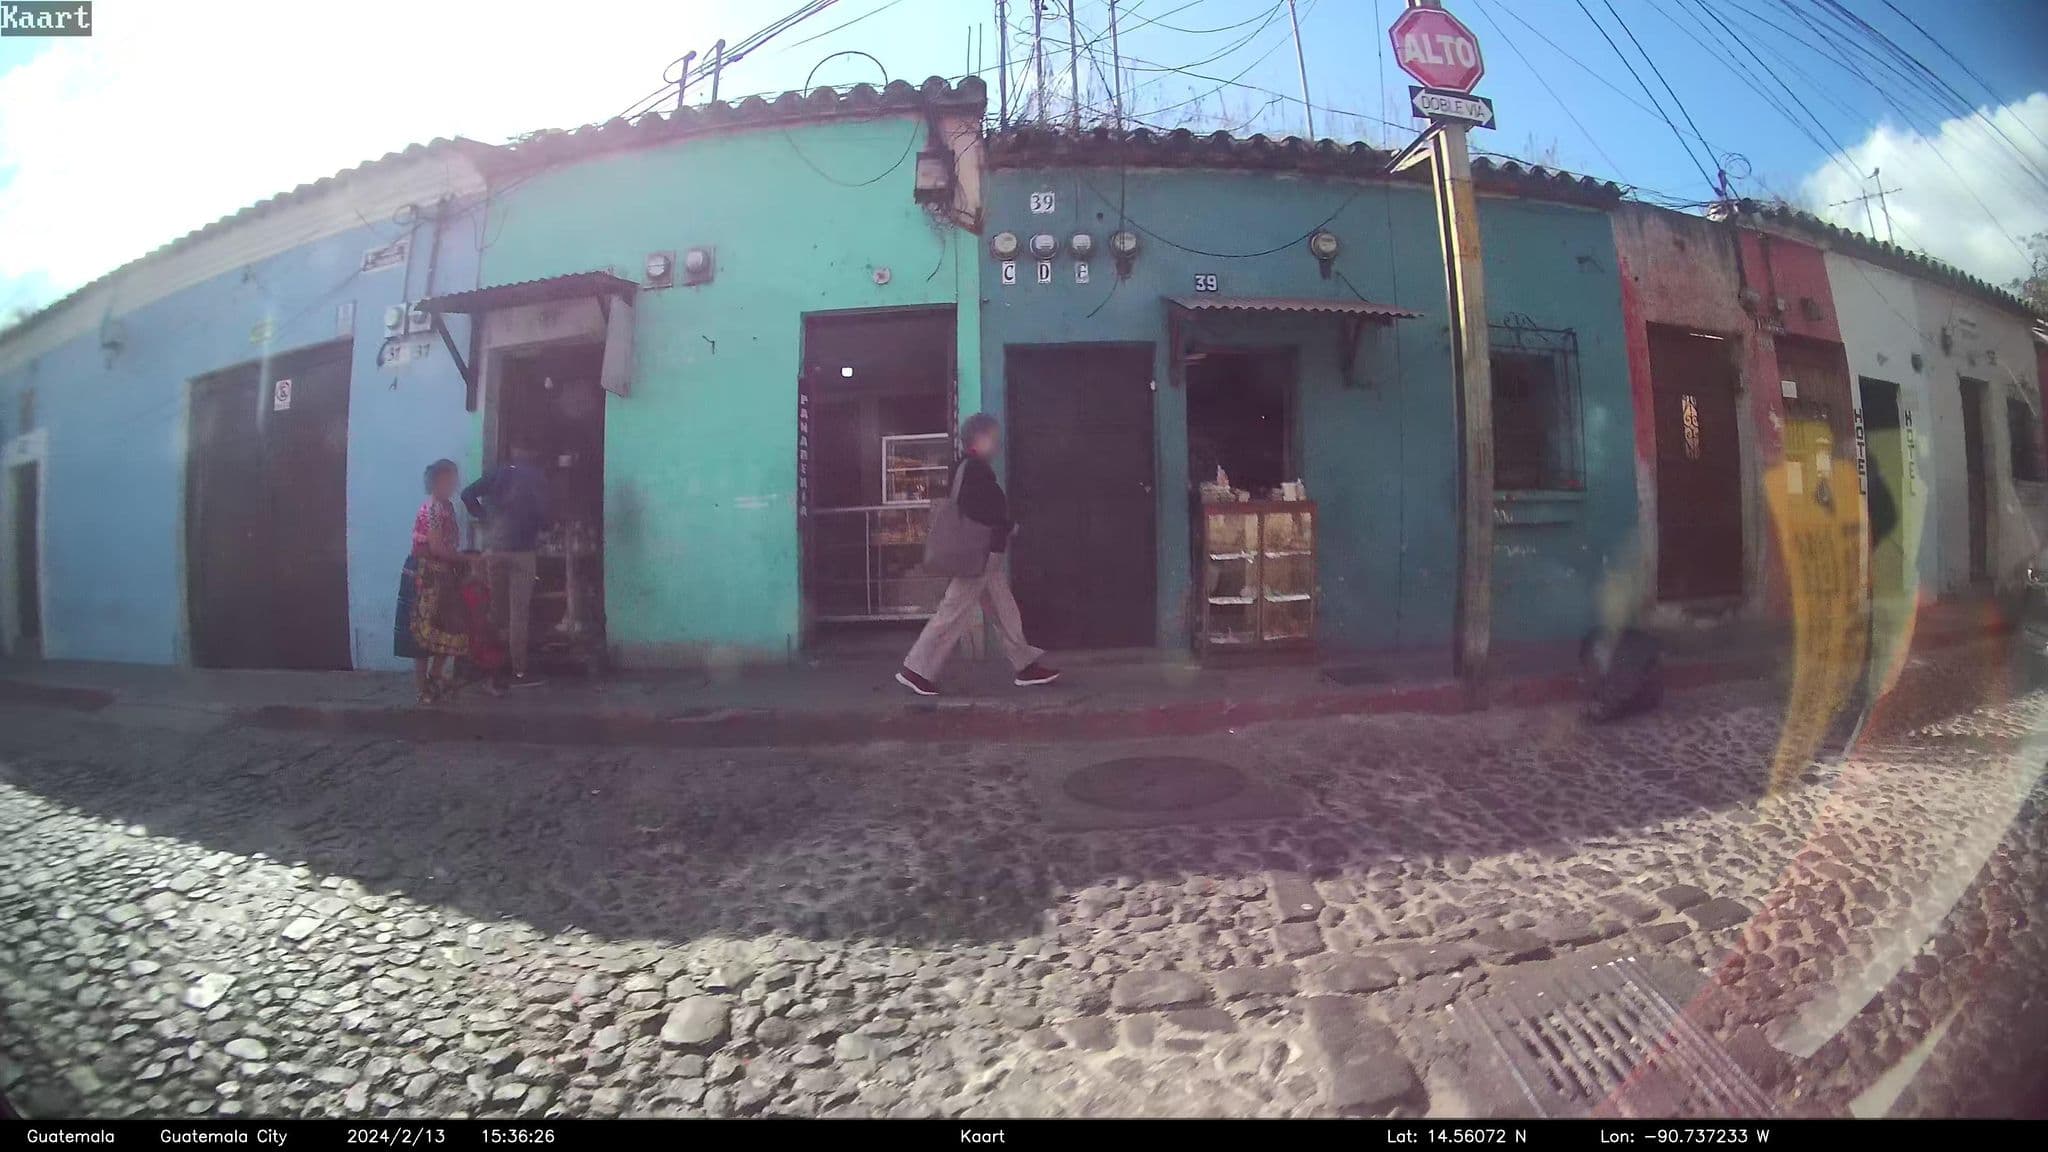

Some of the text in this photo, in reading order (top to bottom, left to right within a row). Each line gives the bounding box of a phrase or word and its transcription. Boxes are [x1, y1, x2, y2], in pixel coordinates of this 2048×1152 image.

[1404, 32, 1475, 69] ALTO
[1421, 95, 1486, 118] DOBLE VIA
[1030, 192, 1055, 212] 39
[1004, 264, 1014, 281] C
[1039, 263, 1050, 281] D
[1194, 274, 1218, 292] 39
[799, 393, 809, 518] PANADERIA
[1854, 408, 1867, 496] HOTEL
[1904, 409, 1917, 497] HOTEL
